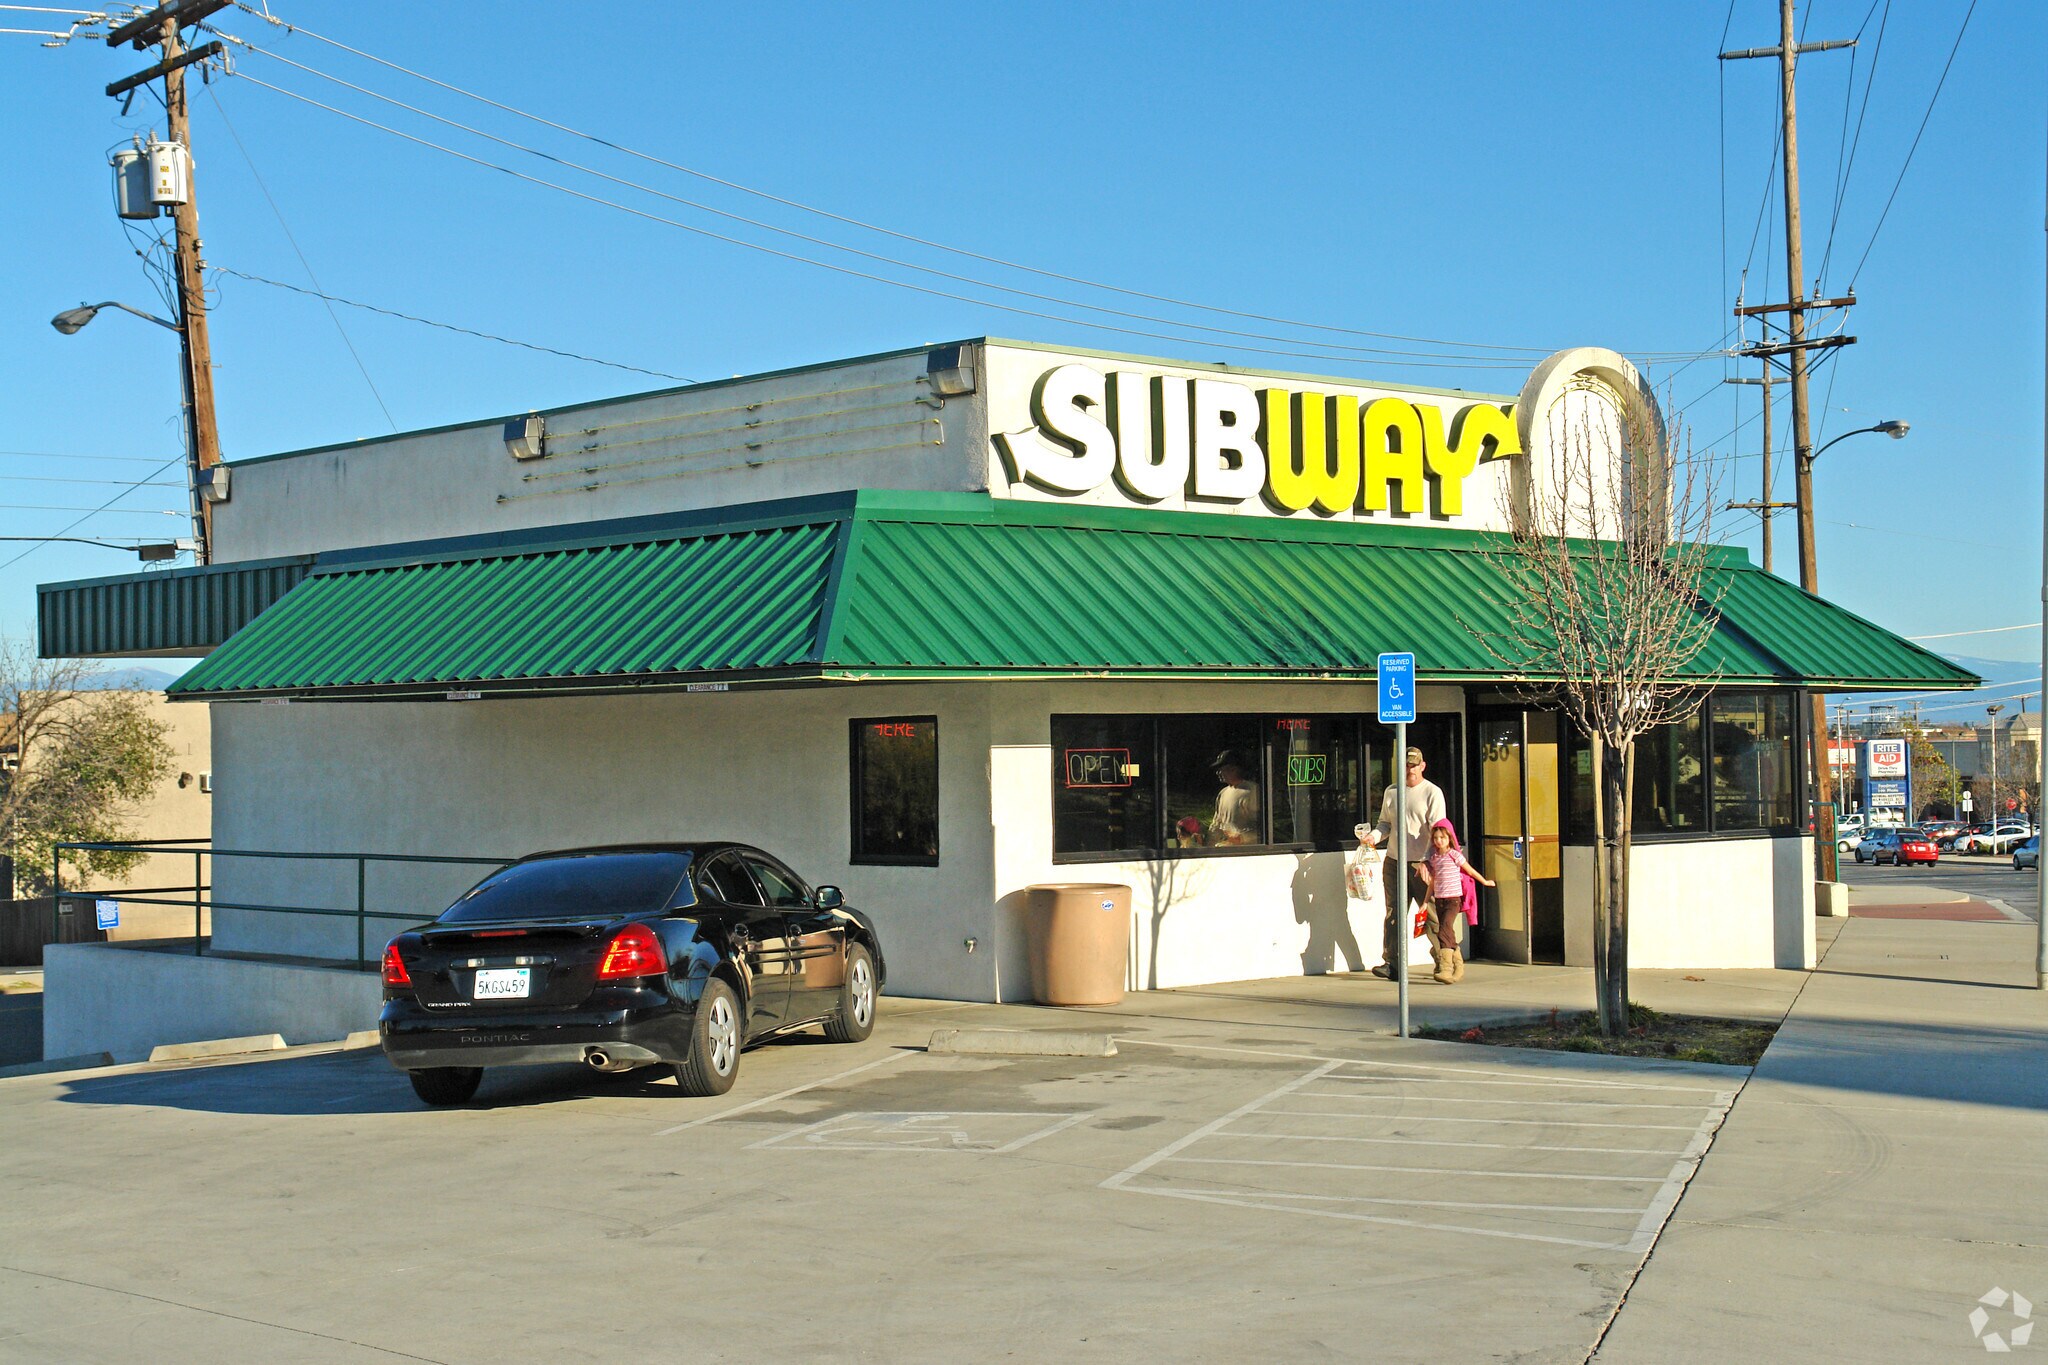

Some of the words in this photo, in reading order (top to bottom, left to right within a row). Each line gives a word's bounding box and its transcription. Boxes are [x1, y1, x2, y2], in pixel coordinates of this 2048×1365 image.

[992, 364, 1522, 516] SUBWAY
[1877, 744, 1898, 752] RITE
[1879, 754, 1897, 763] AID
[1070, 754, 1127, 783] OPEN
[1290, 758, 1325, 782] SUBS
[478, 979, 526, 994] 5KGS459
[461, 1033, 530, 1043] PONTIAC
